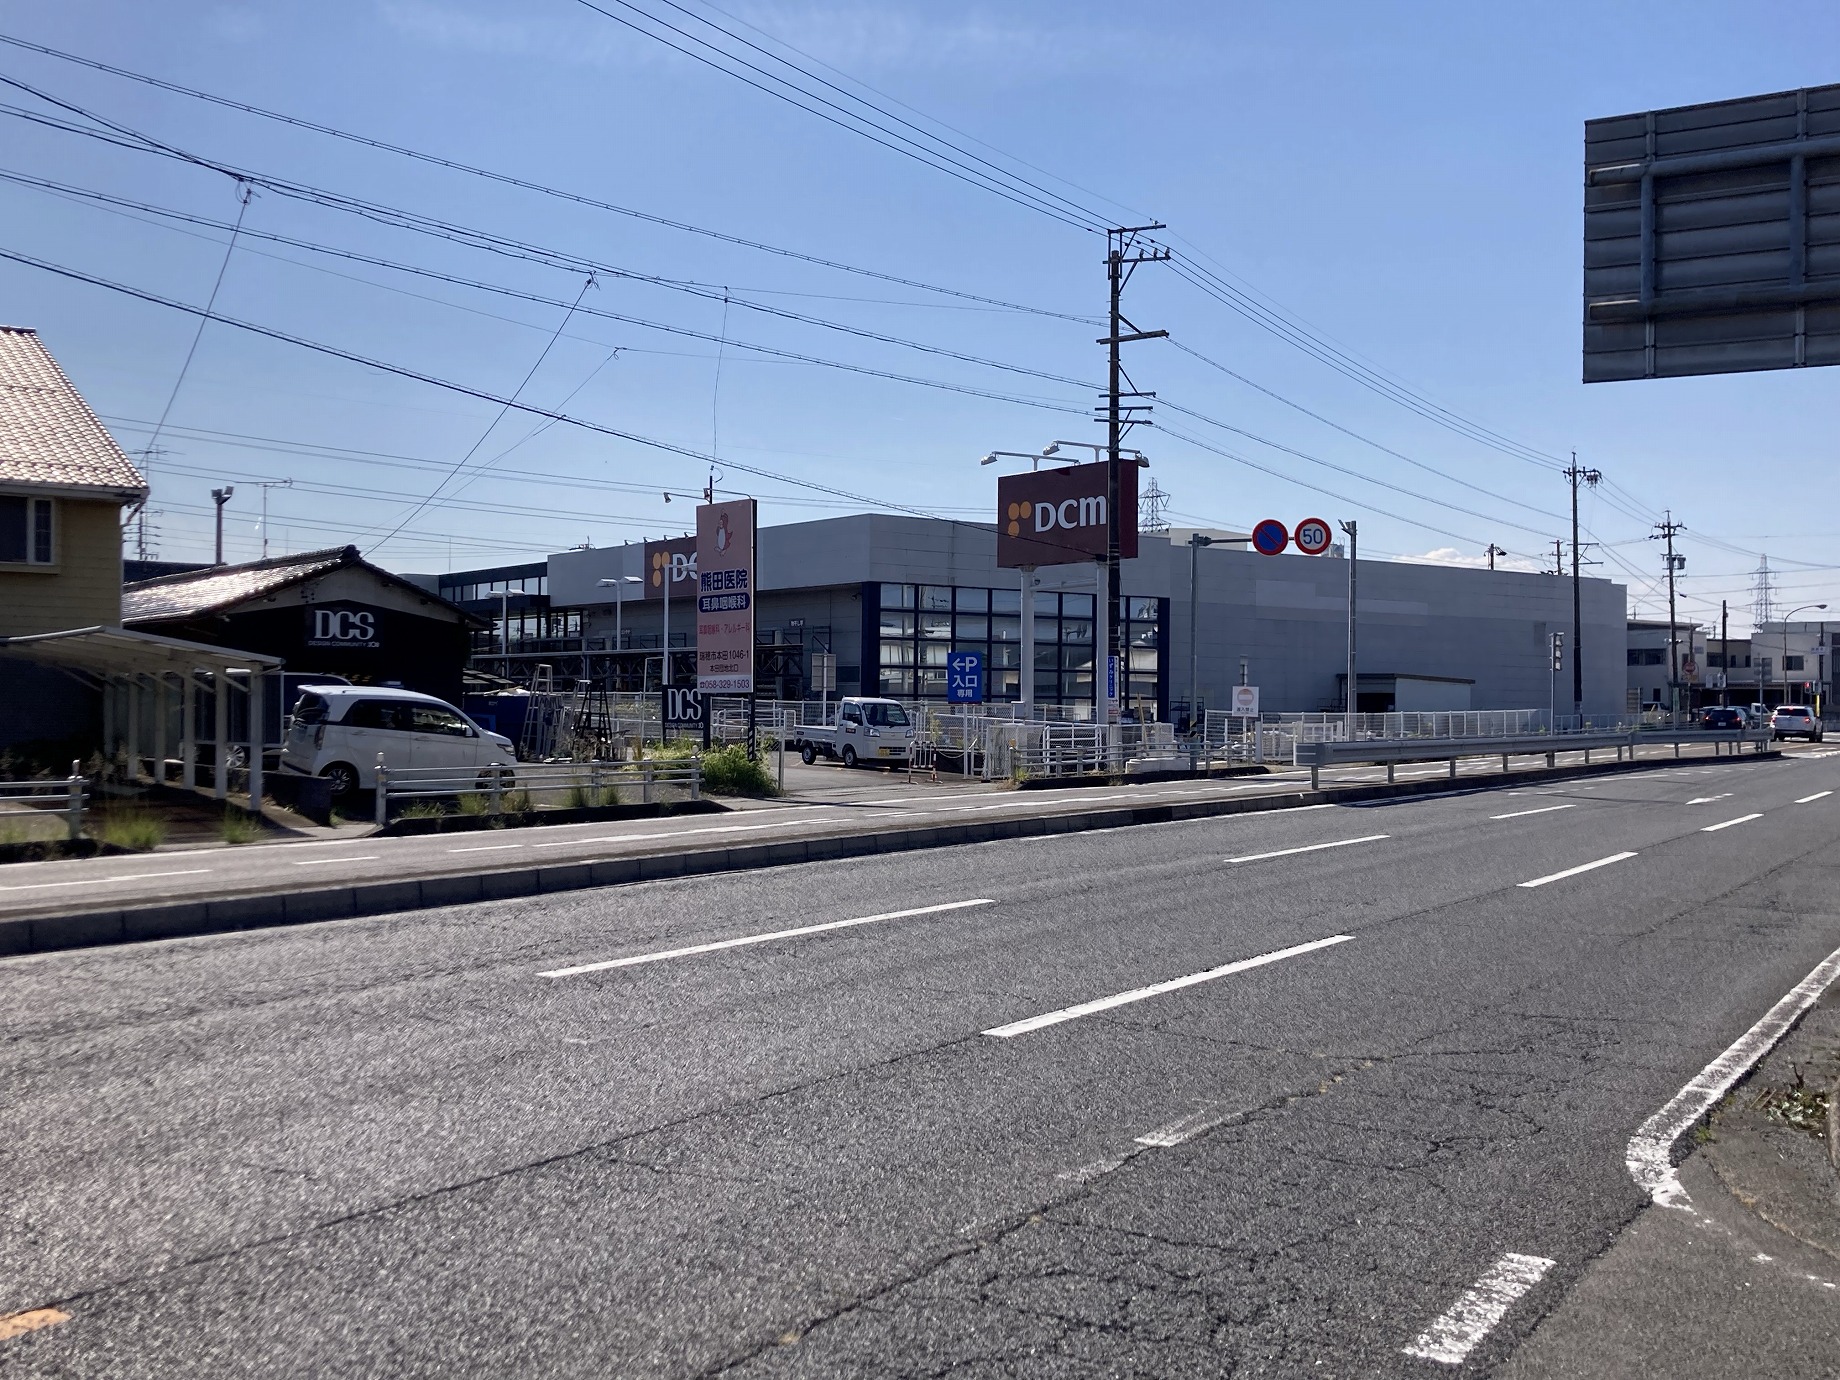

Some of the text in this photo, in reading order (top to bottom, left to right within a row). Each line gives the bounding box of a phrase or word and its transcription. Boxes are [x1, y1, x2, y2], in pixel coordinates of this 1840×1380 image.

[1303, 529, 1323, 544] 50
[701, 569, 748, 592] 熊田医院
[702, 595, 746, 611] 耳鼻咽喉科
[314, 610, 375, 640] DCS
[965, 657, 978, 672] P
[952, 675, 978, 688] 入口
[667, 688, 702, 720] DCS
